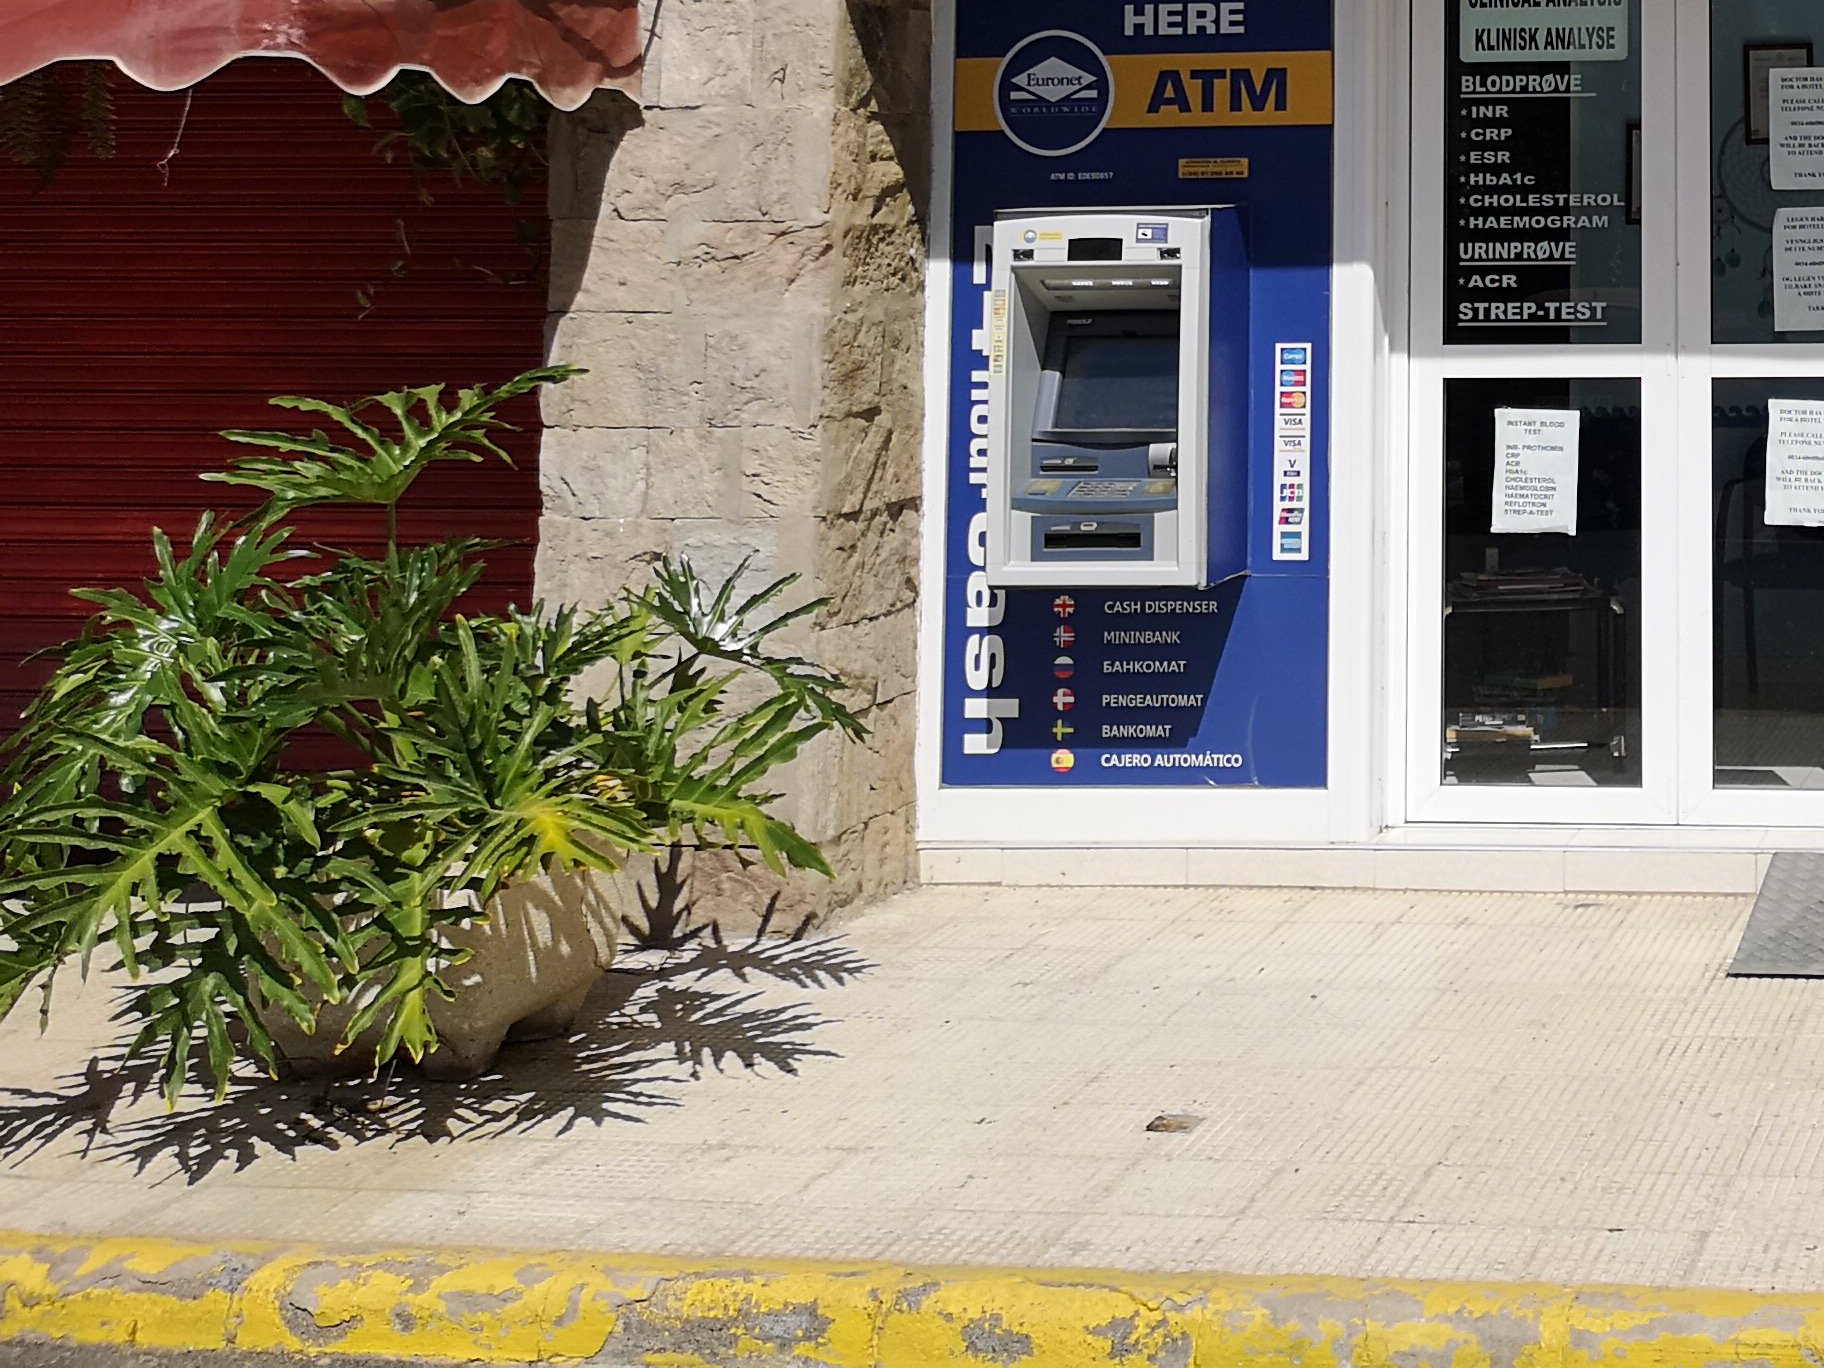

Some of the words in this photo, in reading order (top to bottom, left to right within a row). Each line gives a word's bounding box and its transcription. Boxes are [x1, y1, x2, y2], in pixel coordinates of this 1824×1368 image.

[1123, 2, 1246, 36] HERE
[1475, 27, 1540, 52] KLINISK
[1544, 26, 1616, 51] ANALYSE
[1025, 72, 1084, 88] Euronet
[1461, 74, 1582, 93] BLODPRØVE
[1146, 67, 1288, 115] ATM
[1472, 105, 1509, 119] INR
[1470, 128, 1513, 142] CRP
[1469, 151, 1511, 164] ESR
[1469, 173, 1536, 186] HbA1c
[1469, 193, 1626, 208] CHOLESTEROL
[1469, 215, 1609, 230] HAEMOGRAM
[1459, 241, 1577, 260] URINPRØVE
[1467, 275, 1517, 288] ACR
[1458, 301, 1607, 321] STREP-TEST
[1283, 417, 1303, 426] VISA
[1282, 439, 1302, 448] VISA
[1104, 601, 1141, 614] CASH
[1145, 601, 1218, 614] DISPENSER
[1102, 660, 1187, 674] БАНКОМАТ
[1102, 694, 1203, 708] PENGEAUTOMAT
[1102, 725, 1172, 738] BANKOMAT
[1100, 754, 1152, 767] CAJERO
[1154, 750, 1243, 768] AUTOMÁTICO
